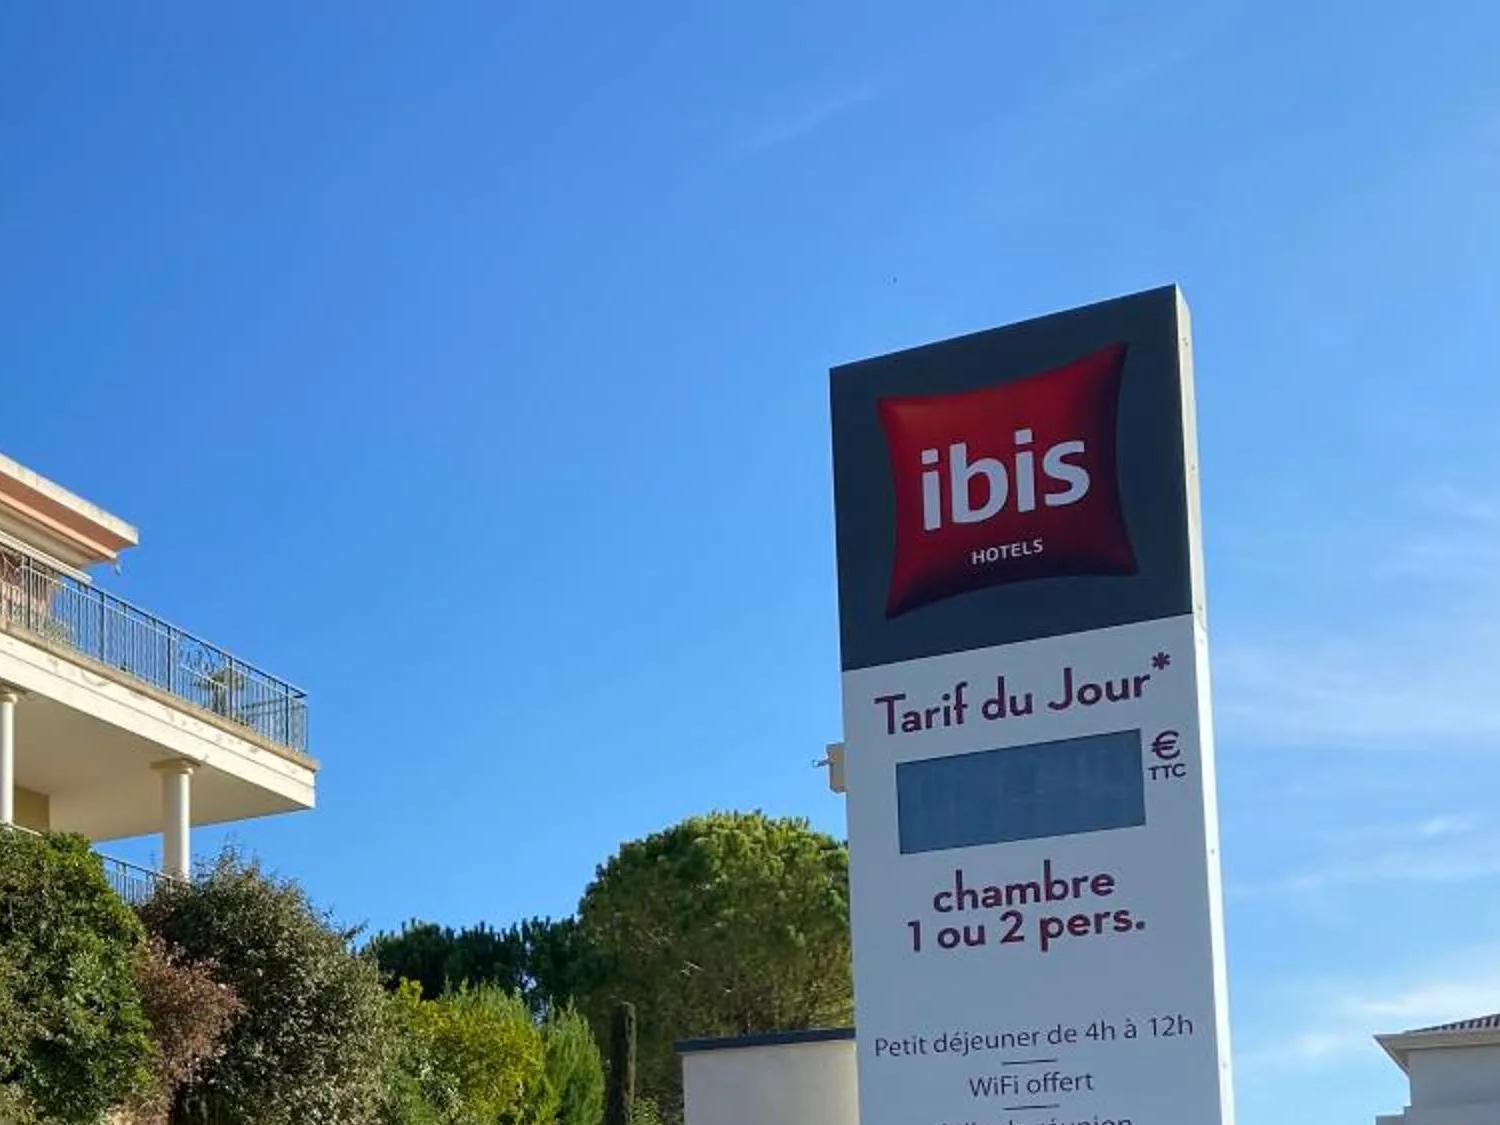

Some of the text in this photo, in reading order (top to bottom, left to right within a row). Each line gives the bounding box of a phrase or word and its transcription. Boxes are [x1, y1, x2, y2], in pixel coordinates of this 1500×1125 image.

[920, 428, 1092, 532] ibis
[971, 538, 1044, 566] HOTELS
[874, 680, 968, 736] Tarif
[981, 675, 1034, 721] du
[1150, 730, 1182, 761] €
[1147, 762, 1187, 782] TTC
[933, 859, 1116, 913] chambre
[906, 906, 1147, 953] 1 ou 2 pers.
[874, 1013, 1194, 1058] Petit déjeuner de 4h à 12h
[968, 1071, 1095, 1098] WiFi offert
